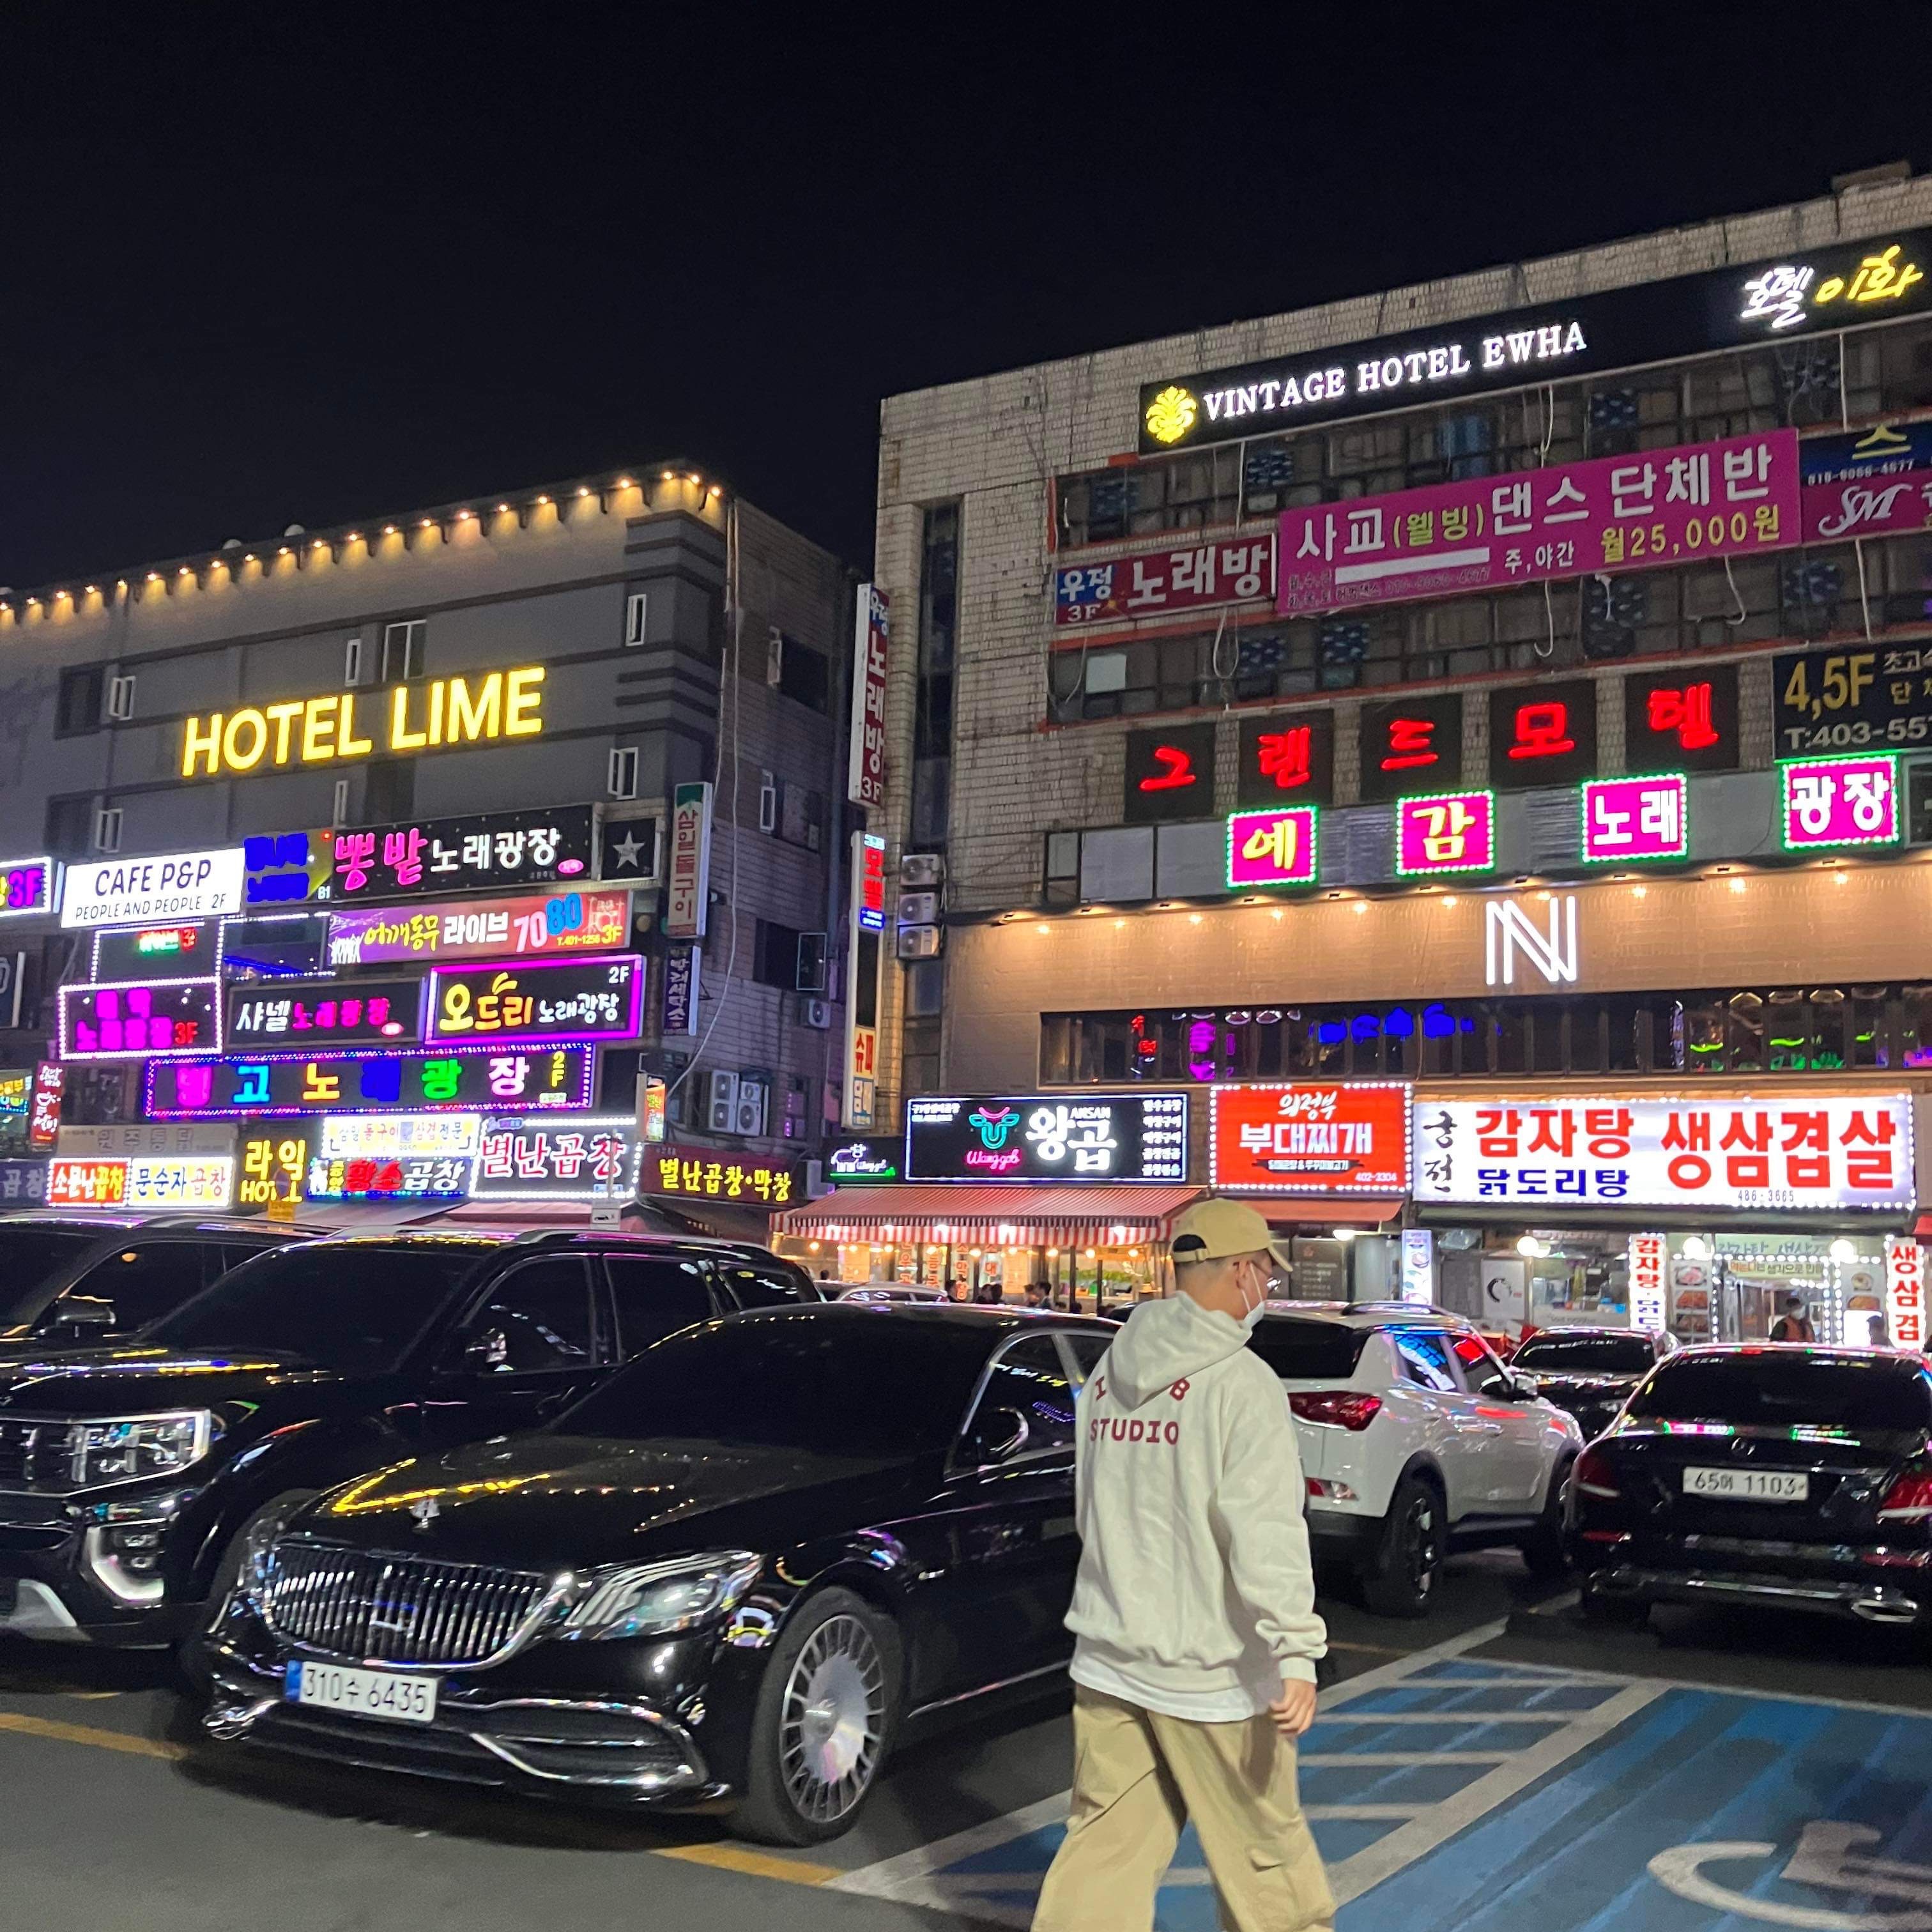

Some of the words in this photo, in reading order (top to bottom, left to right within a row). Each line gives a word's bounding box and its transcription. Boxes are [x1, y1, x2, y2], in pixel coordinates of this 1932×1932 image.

[1741, 266, 1814, 328] 호텔
[1815, 245, 1924, 302] 이화
[1204, 369, 1346, 421] VINTAGE
[1357, 345, 1470, 393] HOTEL
[1483, 321, 1587, 368] EWHA
[1611, 443, 1774, 519] 단체반
[1060, 565, 1114, 602] 우정
[1128, 544, 1268, 608] 노래방
[1068, 604, 1101, 622] 3F
[865, 631, 885, 774] 노래방
[1784, 653, 1876, 721] 4,5F
[182, 694, 373, 778] HOTEL
[390, 666, 547, 750] LIME
[861, 776, 883, 804] 3F
[429, 828, 561, 873] 노래광장
[95, 864, 153, 896] CAFE
[160, 859, 211, 890] P&P
[75, 903, 119, 919] PEOPLE
[124, 901, 151, 915] AND
[155, 896, 201, 912] PEOPLE
[211, 893, 227, 909] 2F
[443, 912, 509, 944] 라이브
[601, 924, 624, 944] 3F
[609, 966, 630, 984] 2F
[235, 1000, 292, 1032] 샤넬
[439, 976, 534, 1031] 오드리
[539, 992, 620, 1023] 노래광장
[174, 1022, 199, 1046] 3F
[1278, 1090, 1338, 1121] 의정부
[480, 1132, 627, 1179] 별난곱창
[1239, 1123, 1372, 1154] 부대찌개
[1475, 1108, 1634, 1160] 감자탕
[1660, 1110, 1898, 1190] 생삼겹살
[240, 1179, 303, 1202] HOTL
[1478, 1169, 1630, 1197] 닭도리탕
[1636, 1239, 1661, 1289] 감자탕
[1892, 1245, 1919, 1341] 생삼겹
[1090, 1418, 1179, 1445] STUDIO
[305, 1668, 361, 1705] 310수
[367, 1678, 427, 1714] 6435
